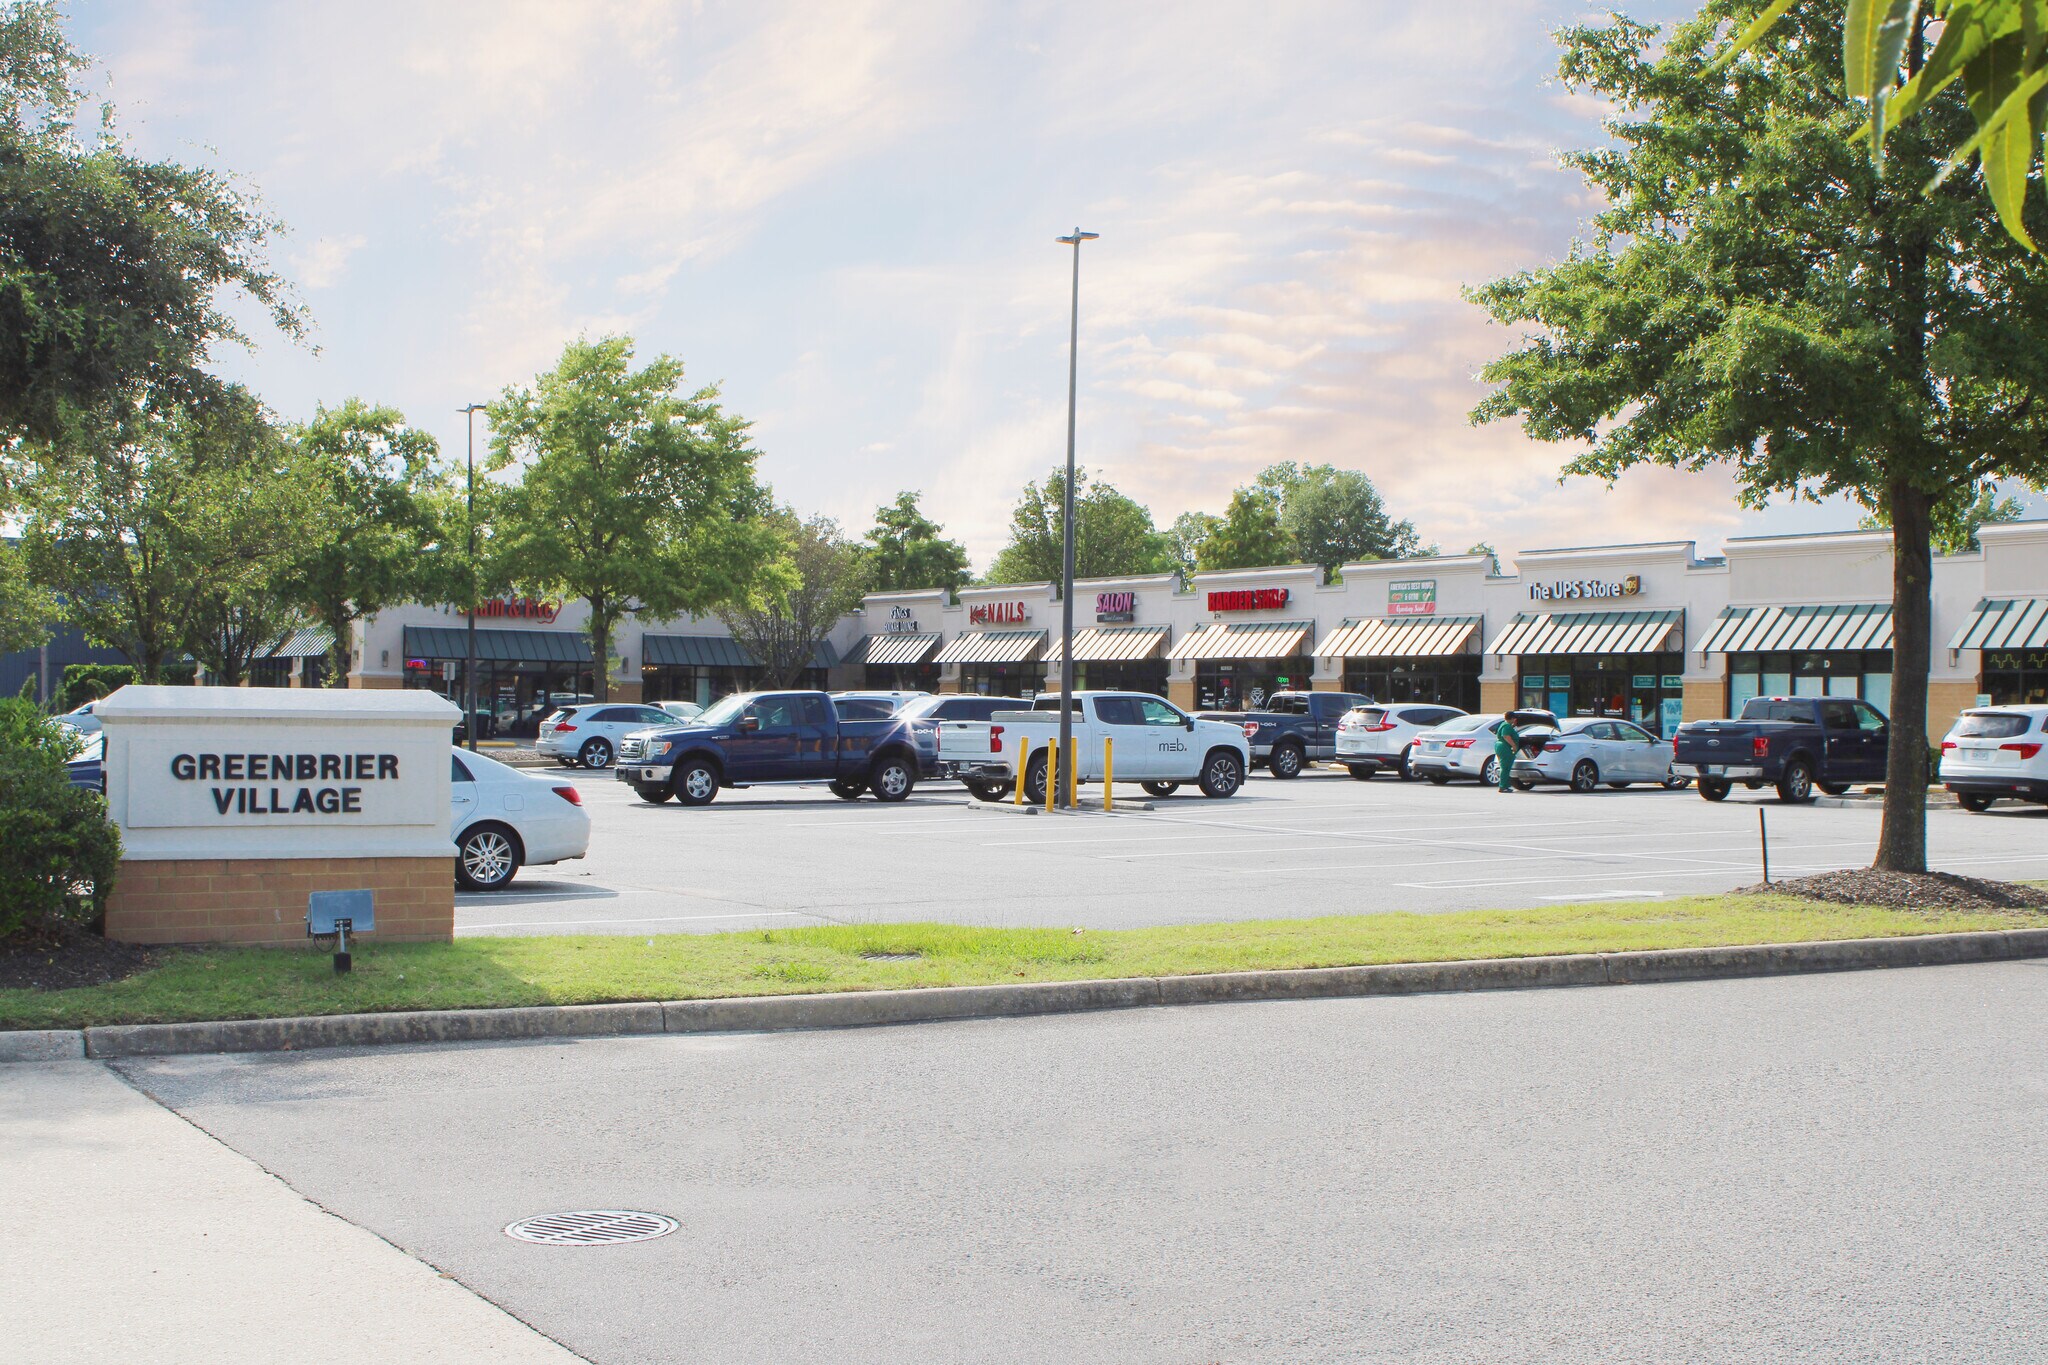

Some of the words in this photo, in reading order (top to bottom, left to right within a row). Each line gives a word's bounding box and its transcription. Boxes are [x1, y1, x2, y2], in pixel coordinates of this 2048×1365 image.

[1208, 590, 1253, 611] BARBER
[1254, 588, 1287, 609] SHOP
[1527, 582, 1550, 600] The
[1553, 580, 1581, 599] UPS
[1584, 579, 1621, 598] Store
[508, 597, 521, 618] &
[524, 597, 557, 620] Eve
[987, 602, 1024, 623] NAILS
[1096, 592, 1134, 613] SALON
[1824, 660, 1830, 668] D
[171, 754, 399, 780] GREENBRIER
[212, 788, 362, 814] VILLAGE
